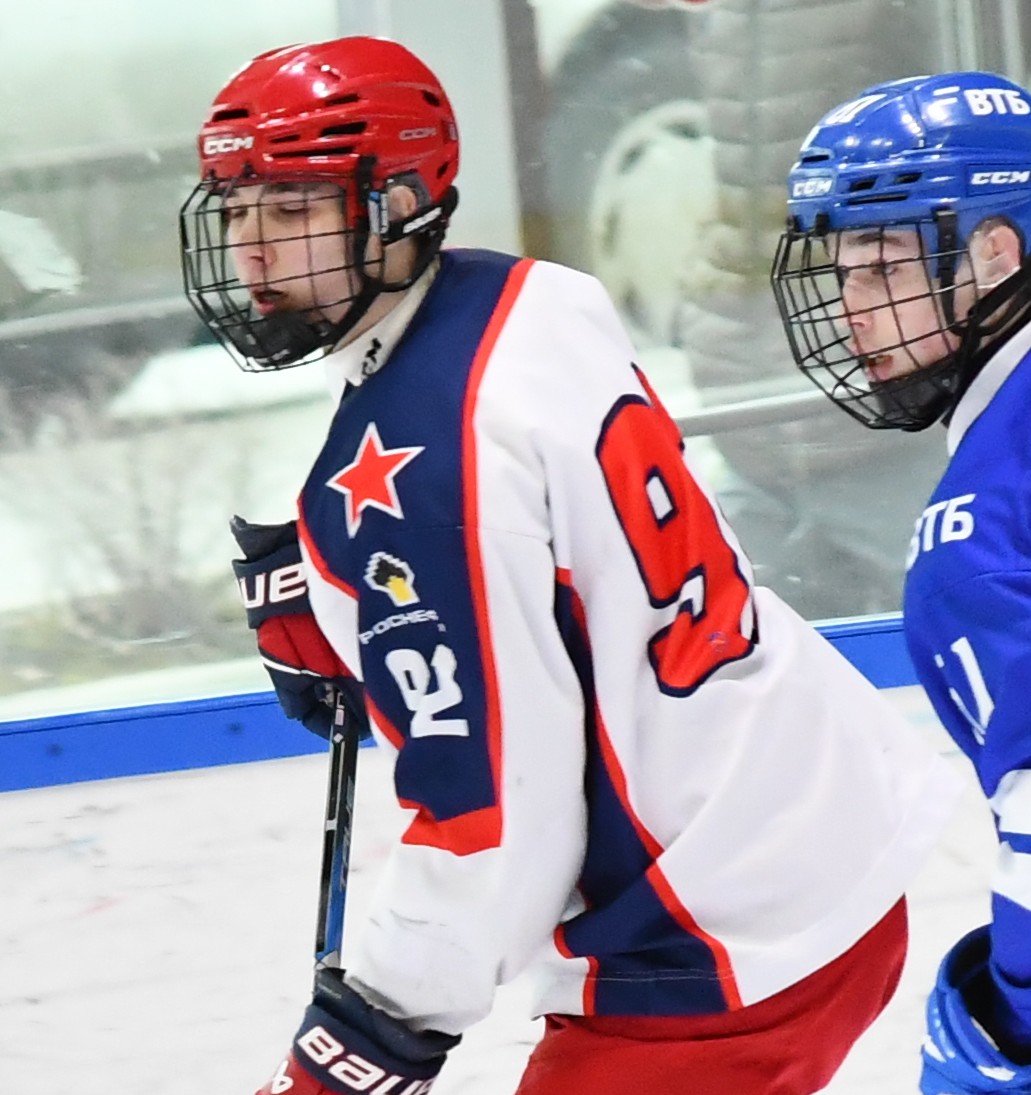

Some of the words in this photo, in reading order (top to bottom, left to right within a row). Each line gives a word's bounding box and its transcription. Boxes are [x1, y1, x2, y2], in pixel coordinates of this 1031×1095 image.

[963, 87, 1031, 116] ВТБ
[203, 136, 255, 155] CCM
[792, 178, 833, 198] CCM
[970, 170, 1031, 186] CCM
[595, 380, 758, 698] 9
